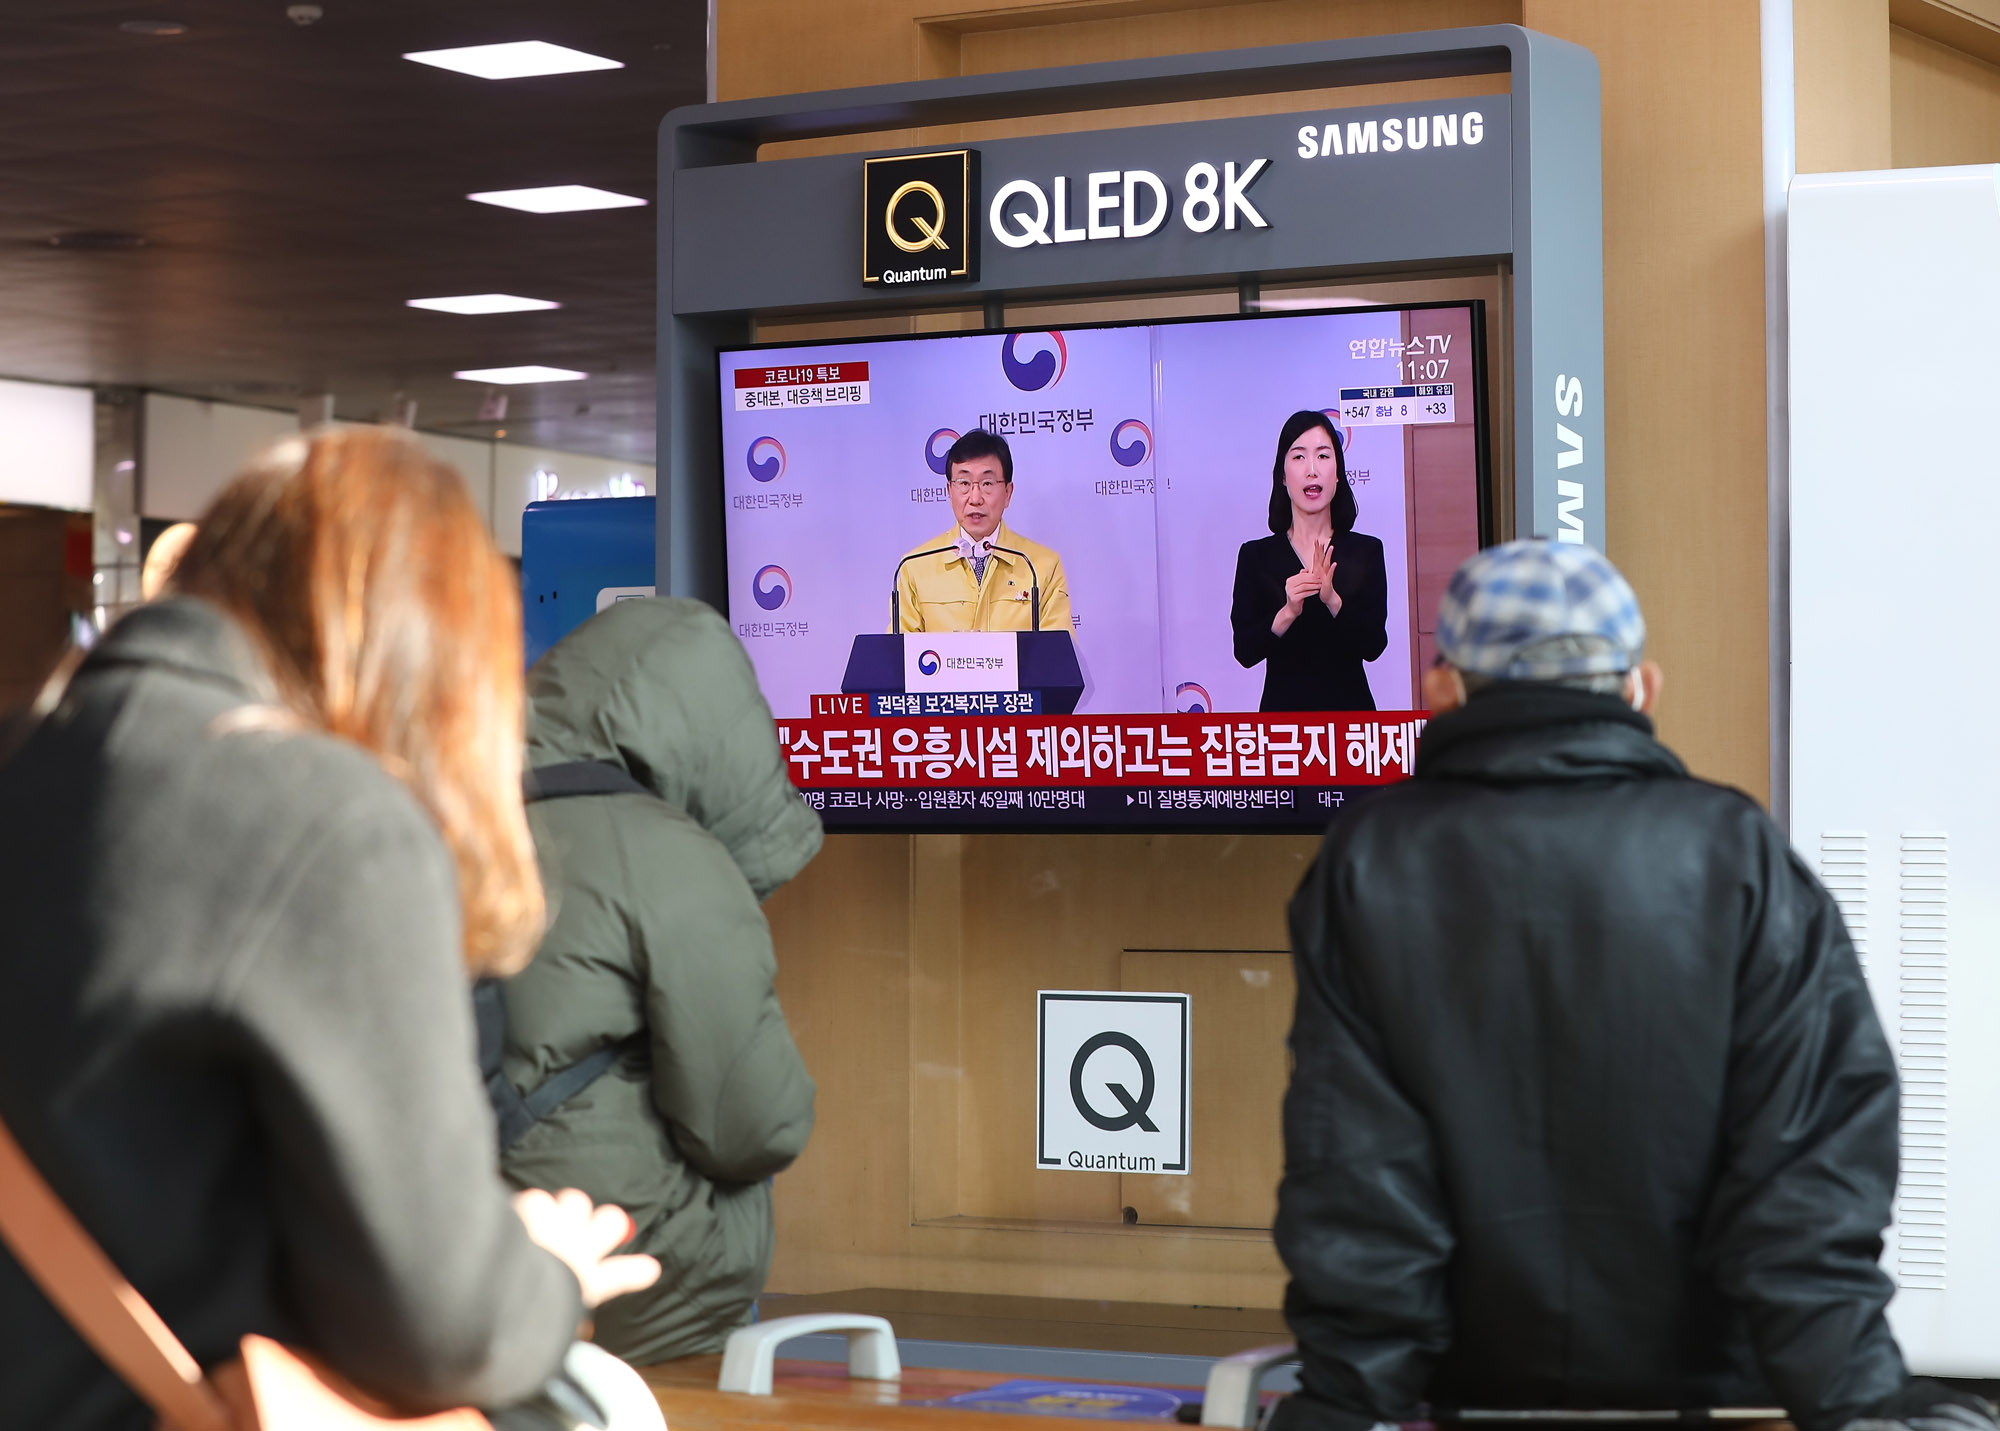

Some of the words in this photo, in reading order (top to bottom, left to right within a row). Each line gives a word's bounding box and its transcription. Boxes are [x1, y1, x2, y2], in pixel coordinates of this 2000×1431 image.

[1297, 111, 1485, 159] SAMSUNG
[989, 170, 1168, 248] QLED
[1182, 159, 1269, 232] 8K
[885, 180, 950, 253] Q
[883, 267, 947, 284] Quantum
[1349, 335, 1452, 360] 연합뉴스TV
[764, 368, 813, 384] 코로나19
[816, 366, 841, 382] 특보
[1396, 359, 1449, 381] 11:07
[744, 390, 784, 408] 중대본,
[787, 387, 823, 405] 대응책
[826, 385, 861, 402] 브리핑
[1344, 405, 1370, 418] +547
[1375, 405, 1393, 417] 충남
[1400, 404, 1408, 416] 8
[1425, 402, 1447, 415] +33
[979, 408, 1095, 436] 대한민국정부
[733, 493, 803, 510] 대한민국정부
[739, 621, 809, 638] 대한민국정부
[946, 656, 1004, 670] 대한민국정부
[818, 696, 863, 715] LIVE
[877, 695, 921, 715] 권덕철
[925, 694, 999, 713] 보건복지부
[1003, 693, 1034, 712] 장관
[890, 725, 1020, 779] 유흥시설
[1026, 723, 1193, 778] 제외하고는
[1200, 722, 1337, 777] 집합금지
[829, 790, 872, 809] 코로나
[979, 790, 1024, 809] 45일째
[1027, 790, 1086, 809] 10만명대
[1138, 790, 1152, 809] 미
[1157, 789, 1295, 809] 질병통제예방센터의
[1318, 791, 1345, 808] 대구
[1069, 1031, 1161, 1133] Q
[1067, 1150, 1156, 1171] Quantum
